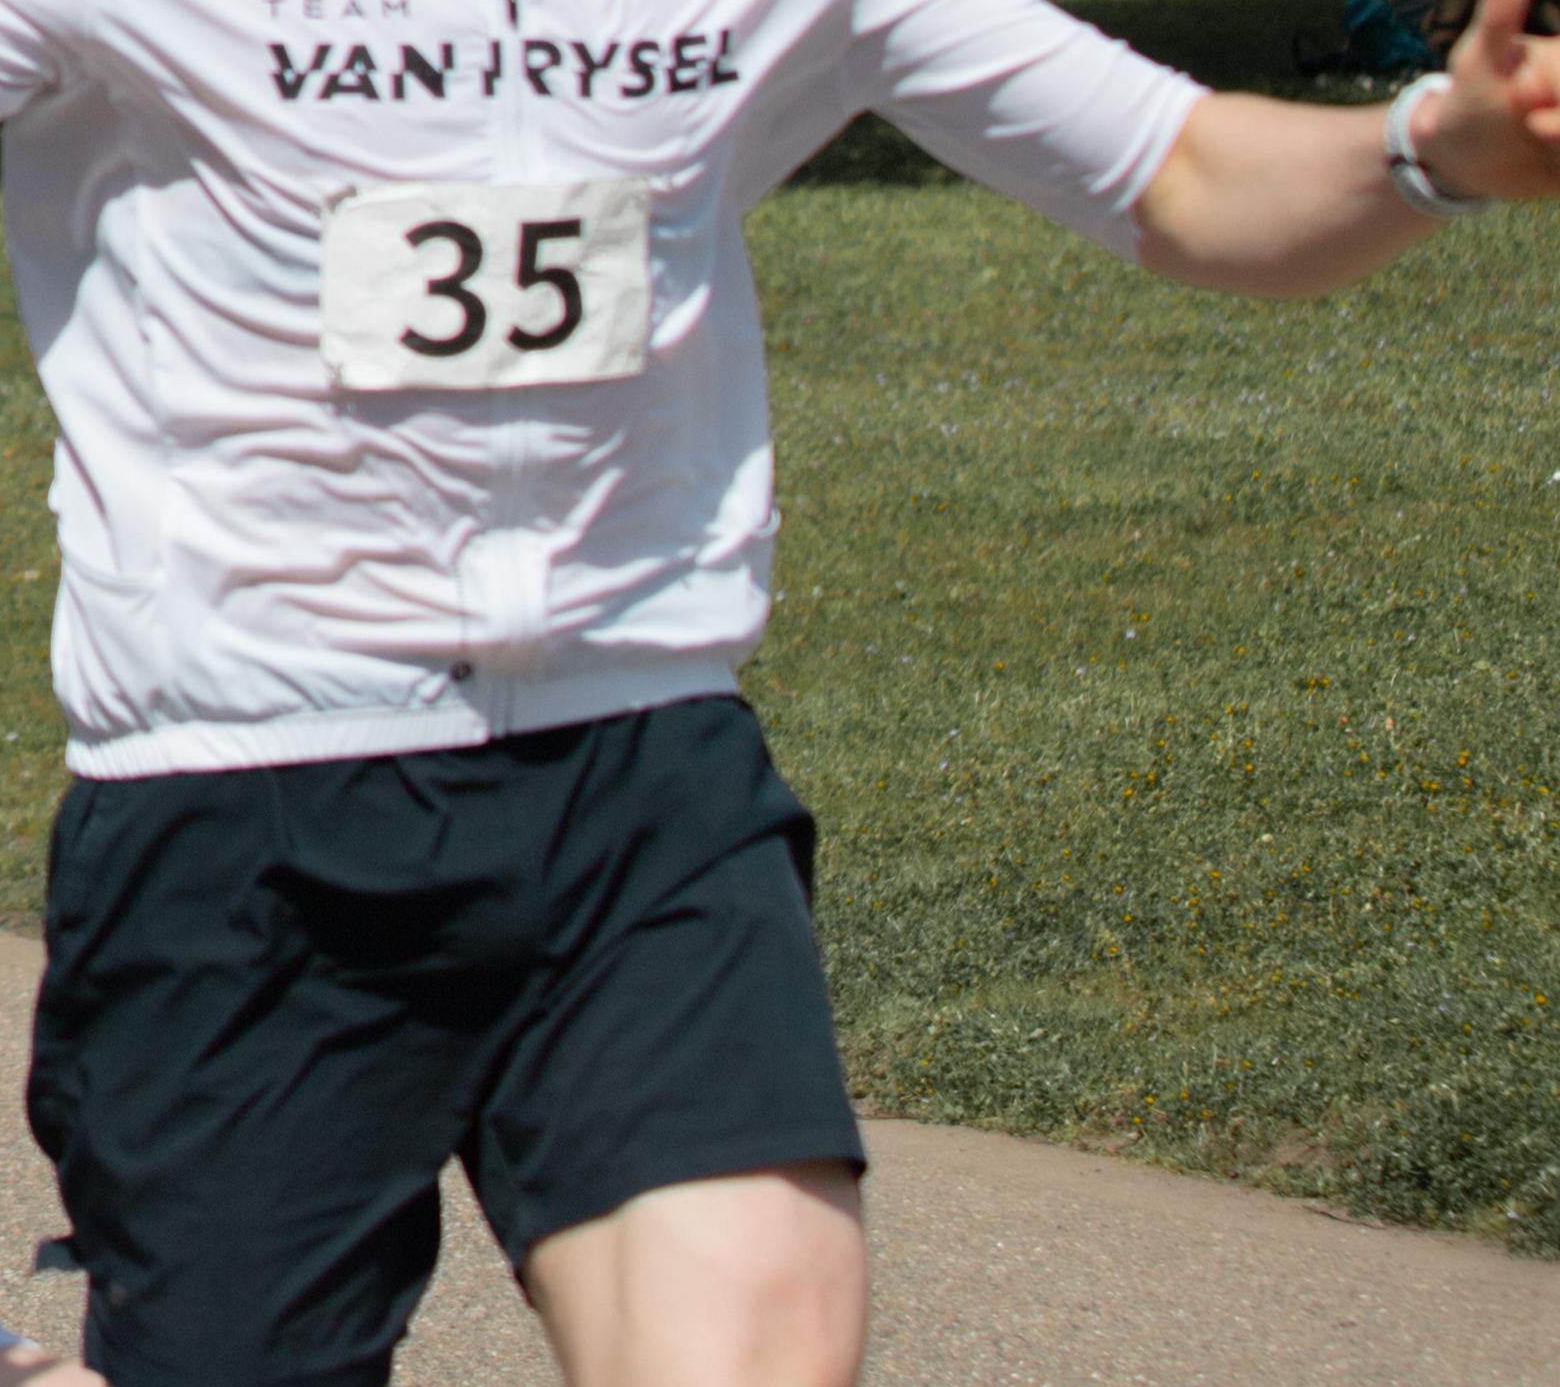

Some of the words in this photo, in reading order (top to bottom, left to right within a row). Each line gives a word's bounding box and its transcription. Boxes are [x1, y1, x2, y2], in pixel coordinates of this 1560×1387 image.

[266, 40, 454, 101] VAN
[481, 28, 740, 100] RYSEL
[399, 218, 584, 357] 35
